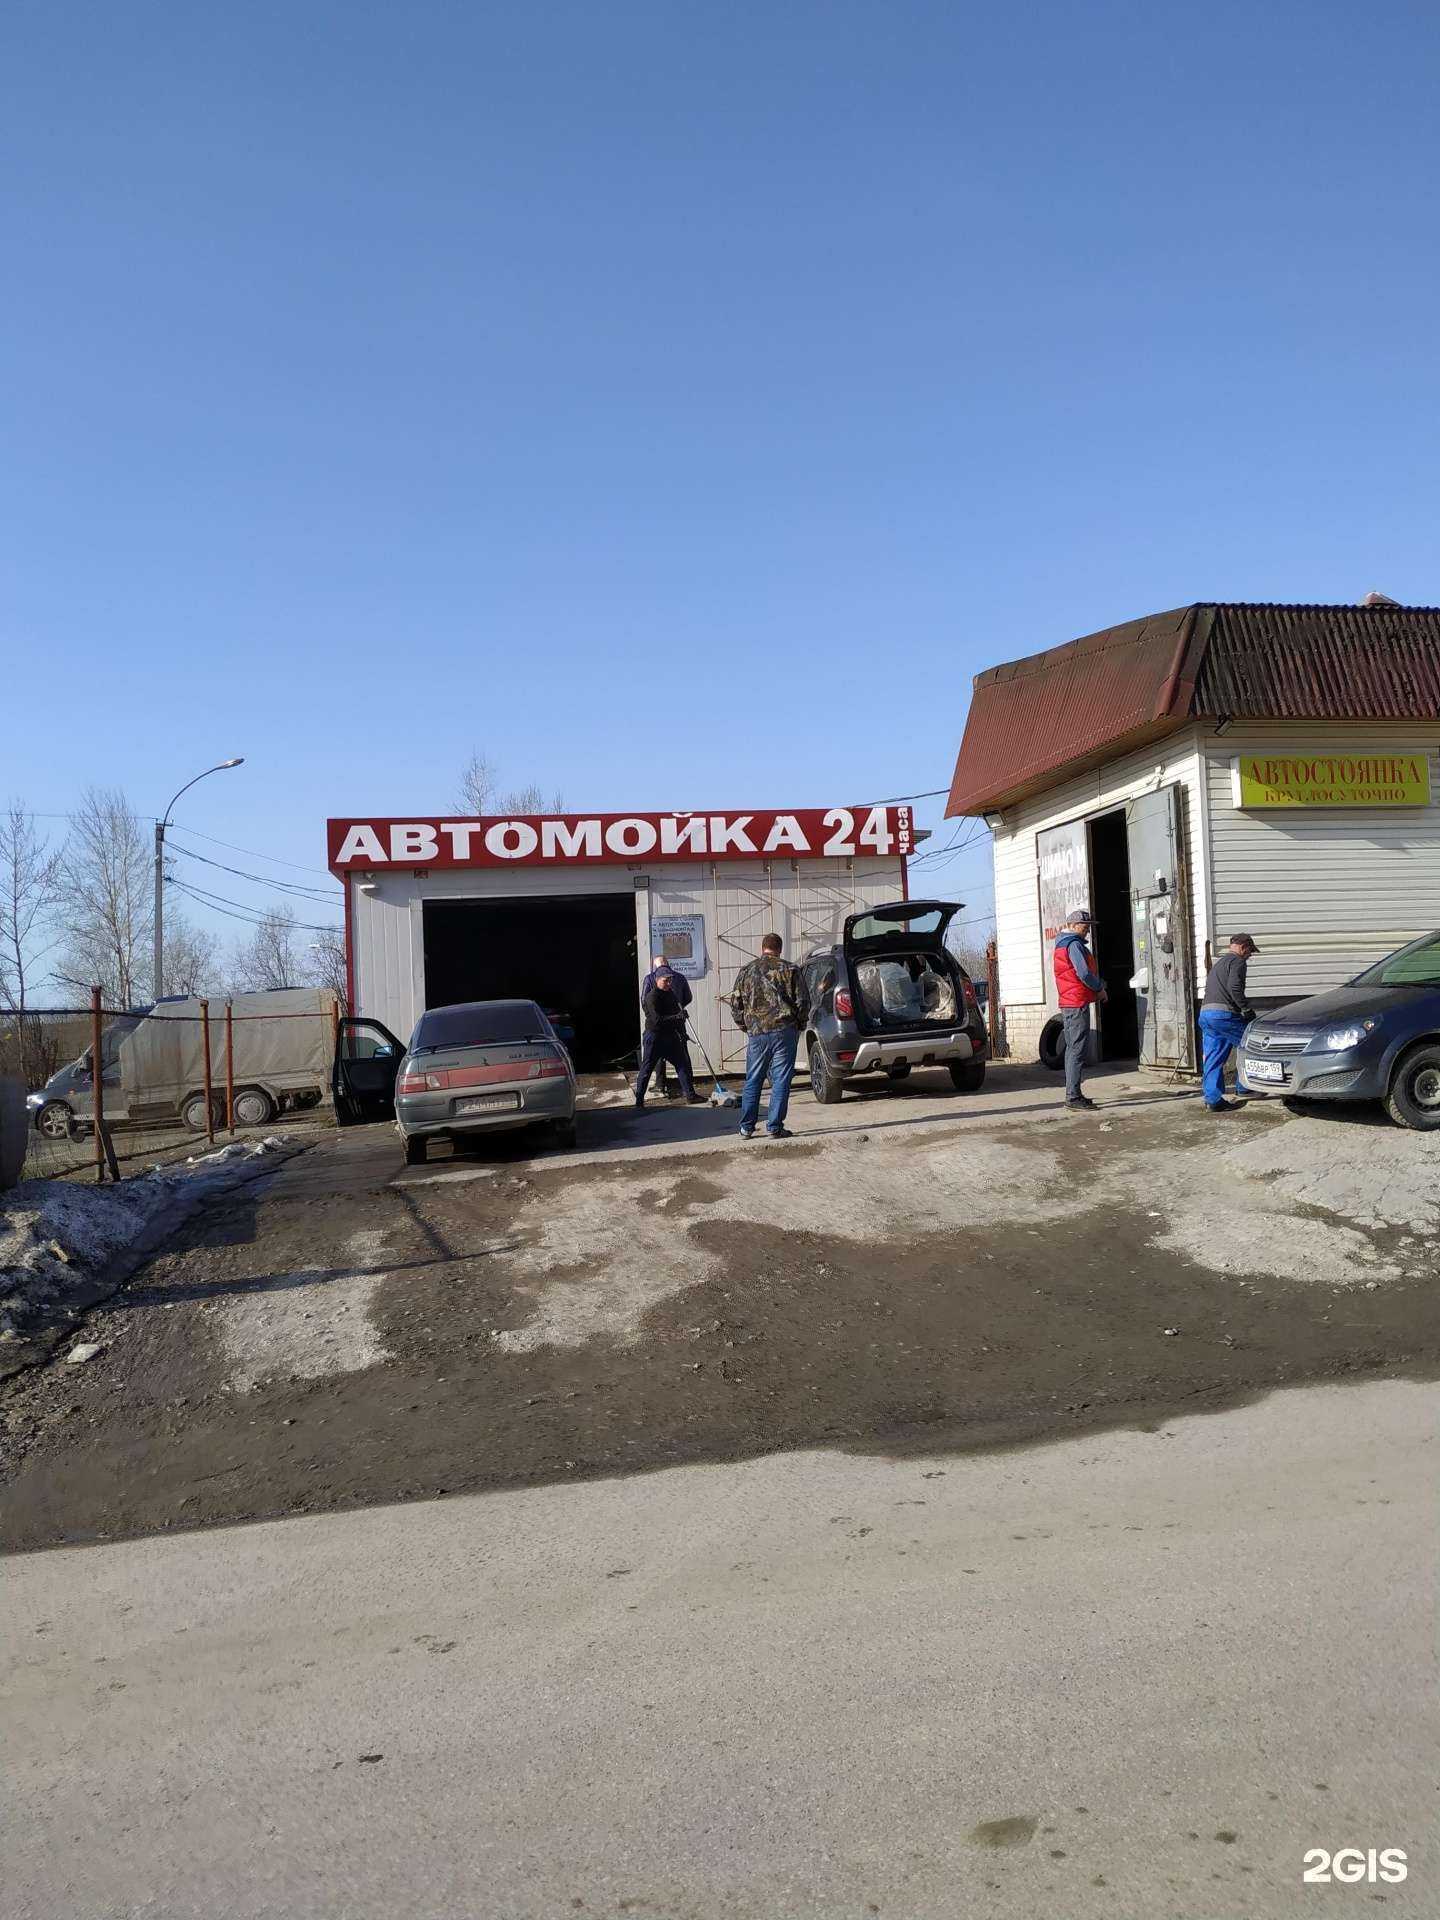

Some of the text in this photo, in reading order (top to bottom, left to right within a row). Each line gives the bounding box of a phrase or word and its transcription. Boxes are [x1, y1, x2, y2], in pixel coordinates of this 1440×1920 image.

[1249, 759, 1421, 785] АВТОСТОЯНКА
[335, 807, 894, 863] АВТОМОЙКА 24
[898, 807, 909, 854] часа
